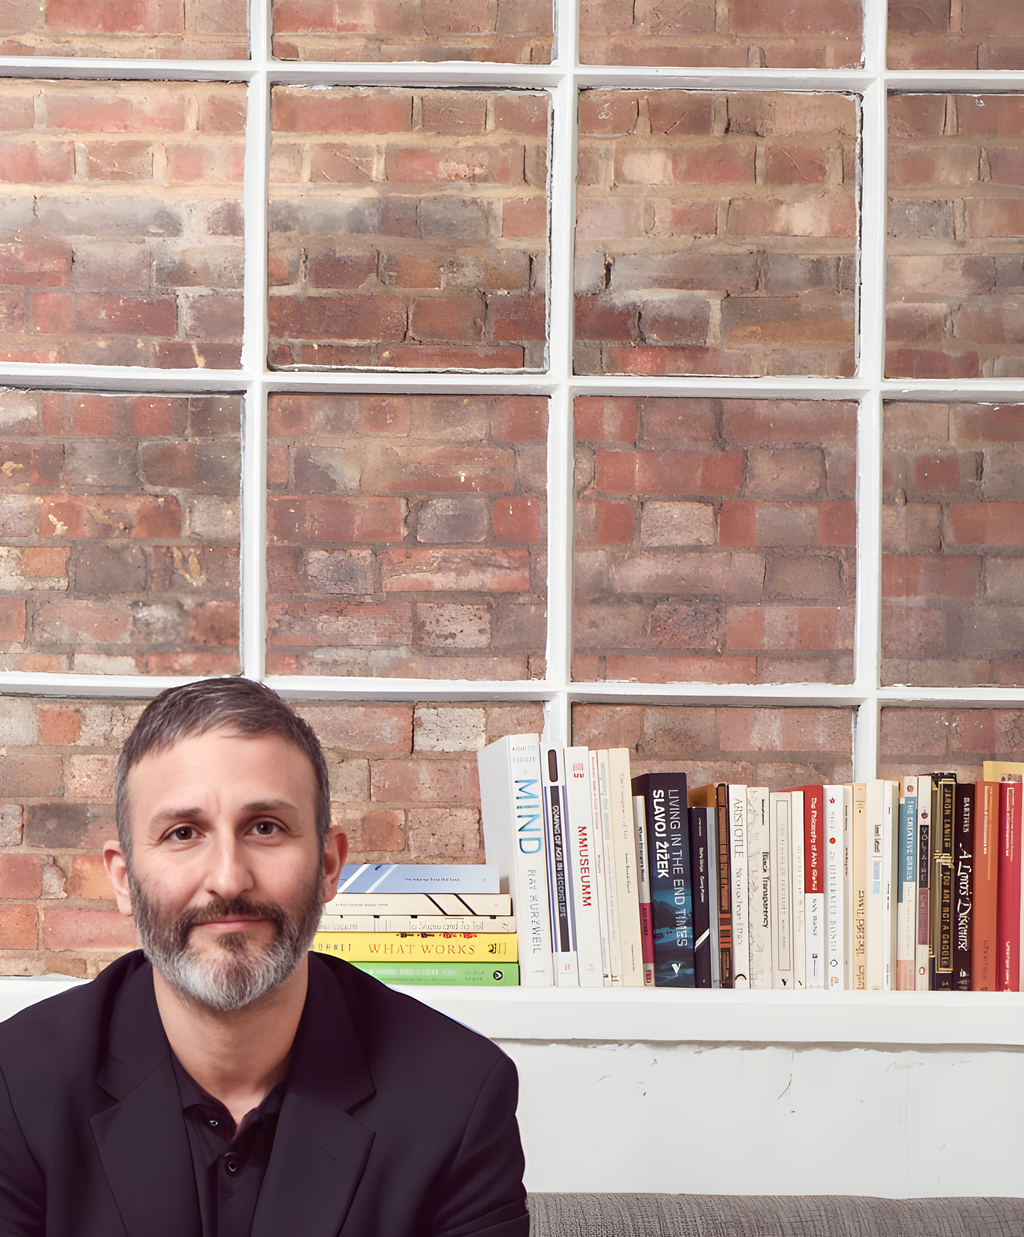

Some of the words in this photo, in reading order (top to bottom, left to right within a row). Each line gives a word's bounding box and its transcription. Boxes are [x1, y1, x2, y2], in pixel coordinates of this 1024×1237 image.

[515, 779, 542, 854] MIND
[653, 789, 666, 837] SLAVOJ
[668, 789, 680, 830] LIVING
[734, 798, 744, 859] ARISTOTLE
[670, 833, 682, 846] IN
[959, 843, 972, 859] A
[578, 826, 592, 906] MMUSEUMM
[672, 849, 684, 874] THE
[673, 879, 685, 905] END
[675, 908, 688, 947] TIMES
[368, 943, 416, 954] WHAT
[420, 944, 476, 955] WORKS
